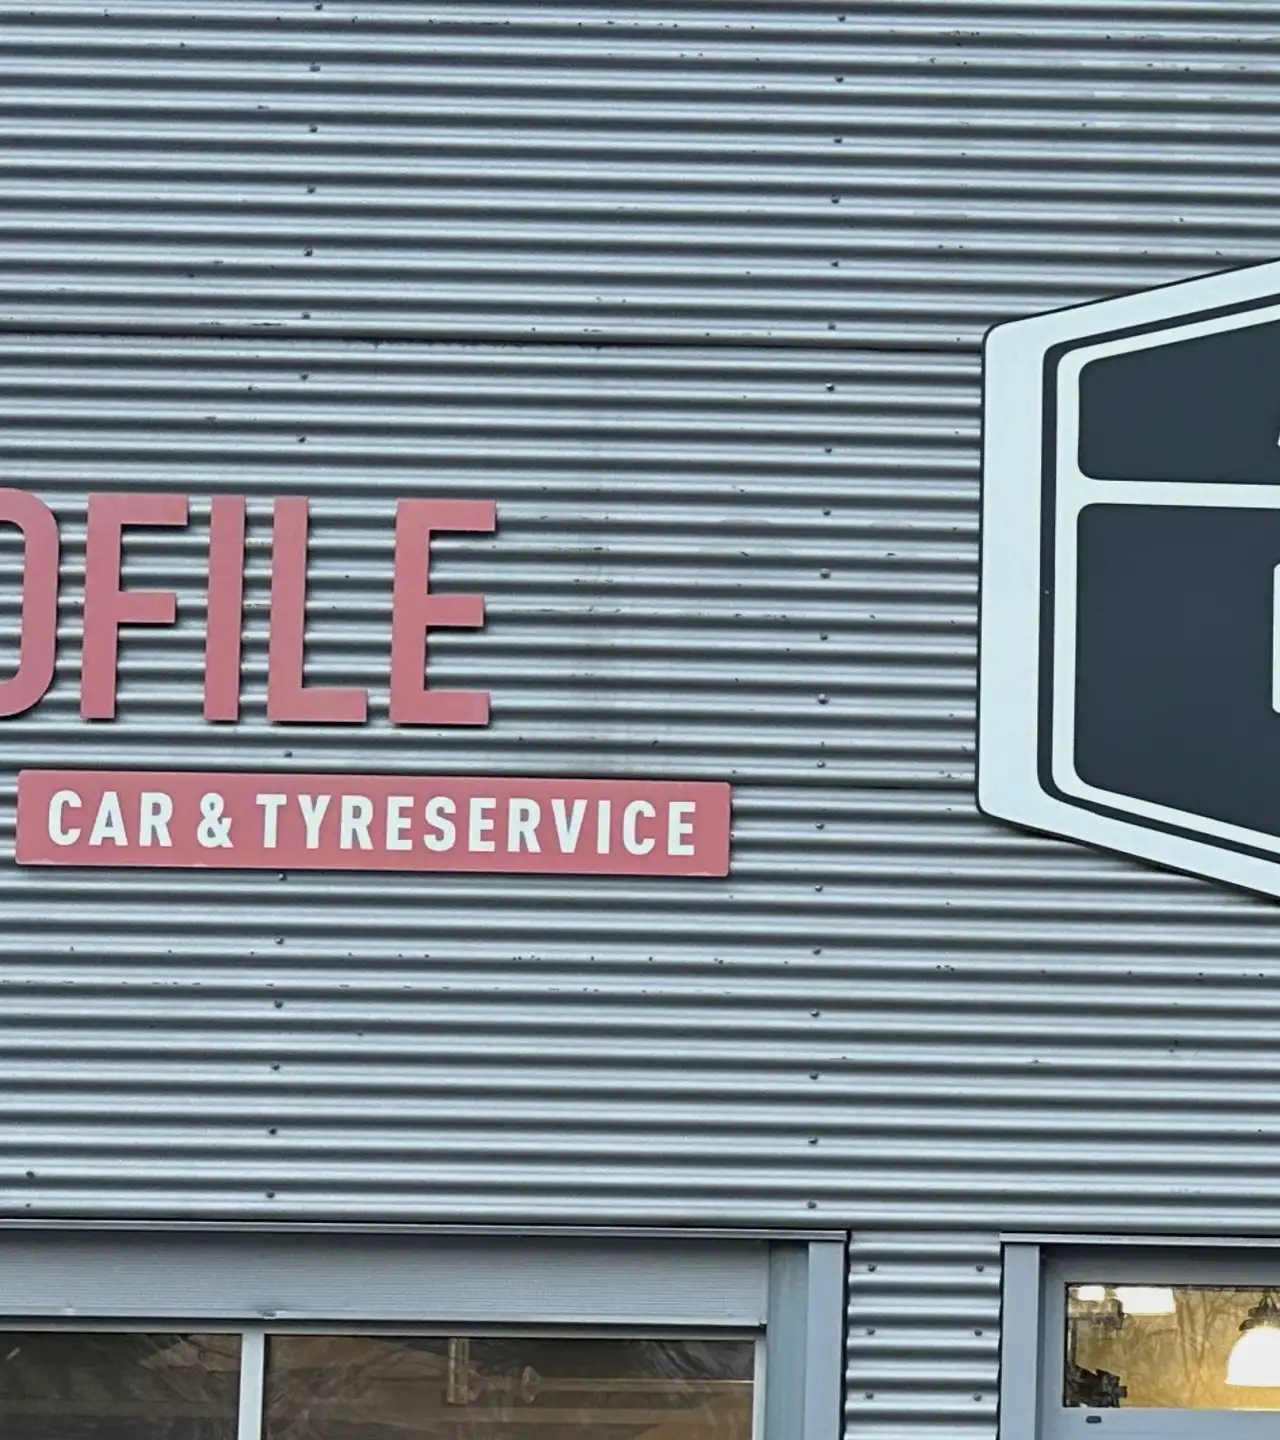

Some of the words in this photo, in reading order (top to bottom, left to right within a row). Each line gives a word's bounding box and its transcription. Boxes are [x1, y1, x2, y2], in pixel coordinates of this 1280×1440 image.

[48, 790, 173, 847] CAR
[196, 792, 234, 848] &
[255, 793, 696, 856] TYRESERVICE
